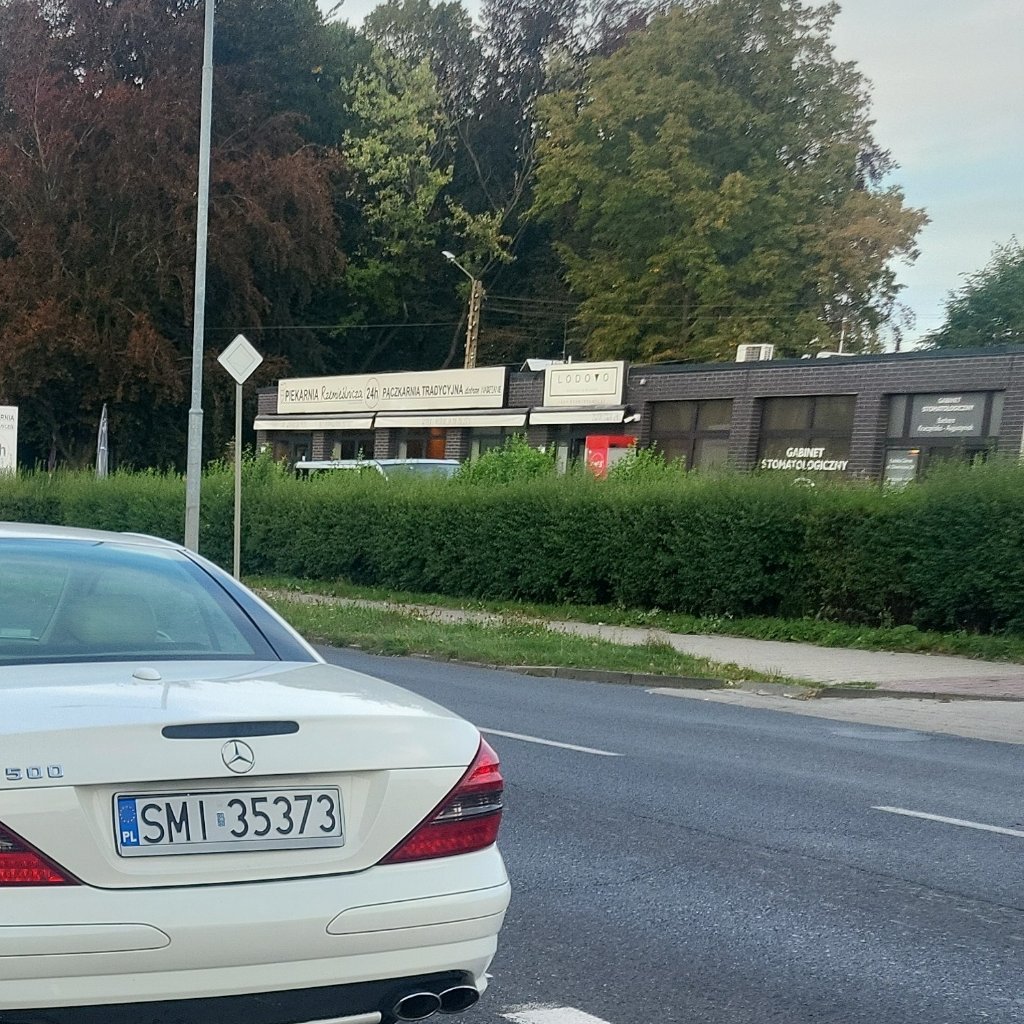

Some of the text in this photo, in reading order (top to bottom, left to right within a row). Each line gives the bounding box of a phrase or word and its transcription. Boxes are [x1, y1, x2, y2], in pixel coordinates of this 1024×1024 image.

[285, 387, 319, 401] PIEKARNIA
[366, 387, 379, 400] 24h
[422, 384, 463, 396] TRADYCYJNA
[786, 447, 825, 458] GABINET
[761, 458, 849, 471] STOMATOLOGICZNY
[5, 764, 64, 780] 500
[122, 794, 337, 844] PL SMI 35373
